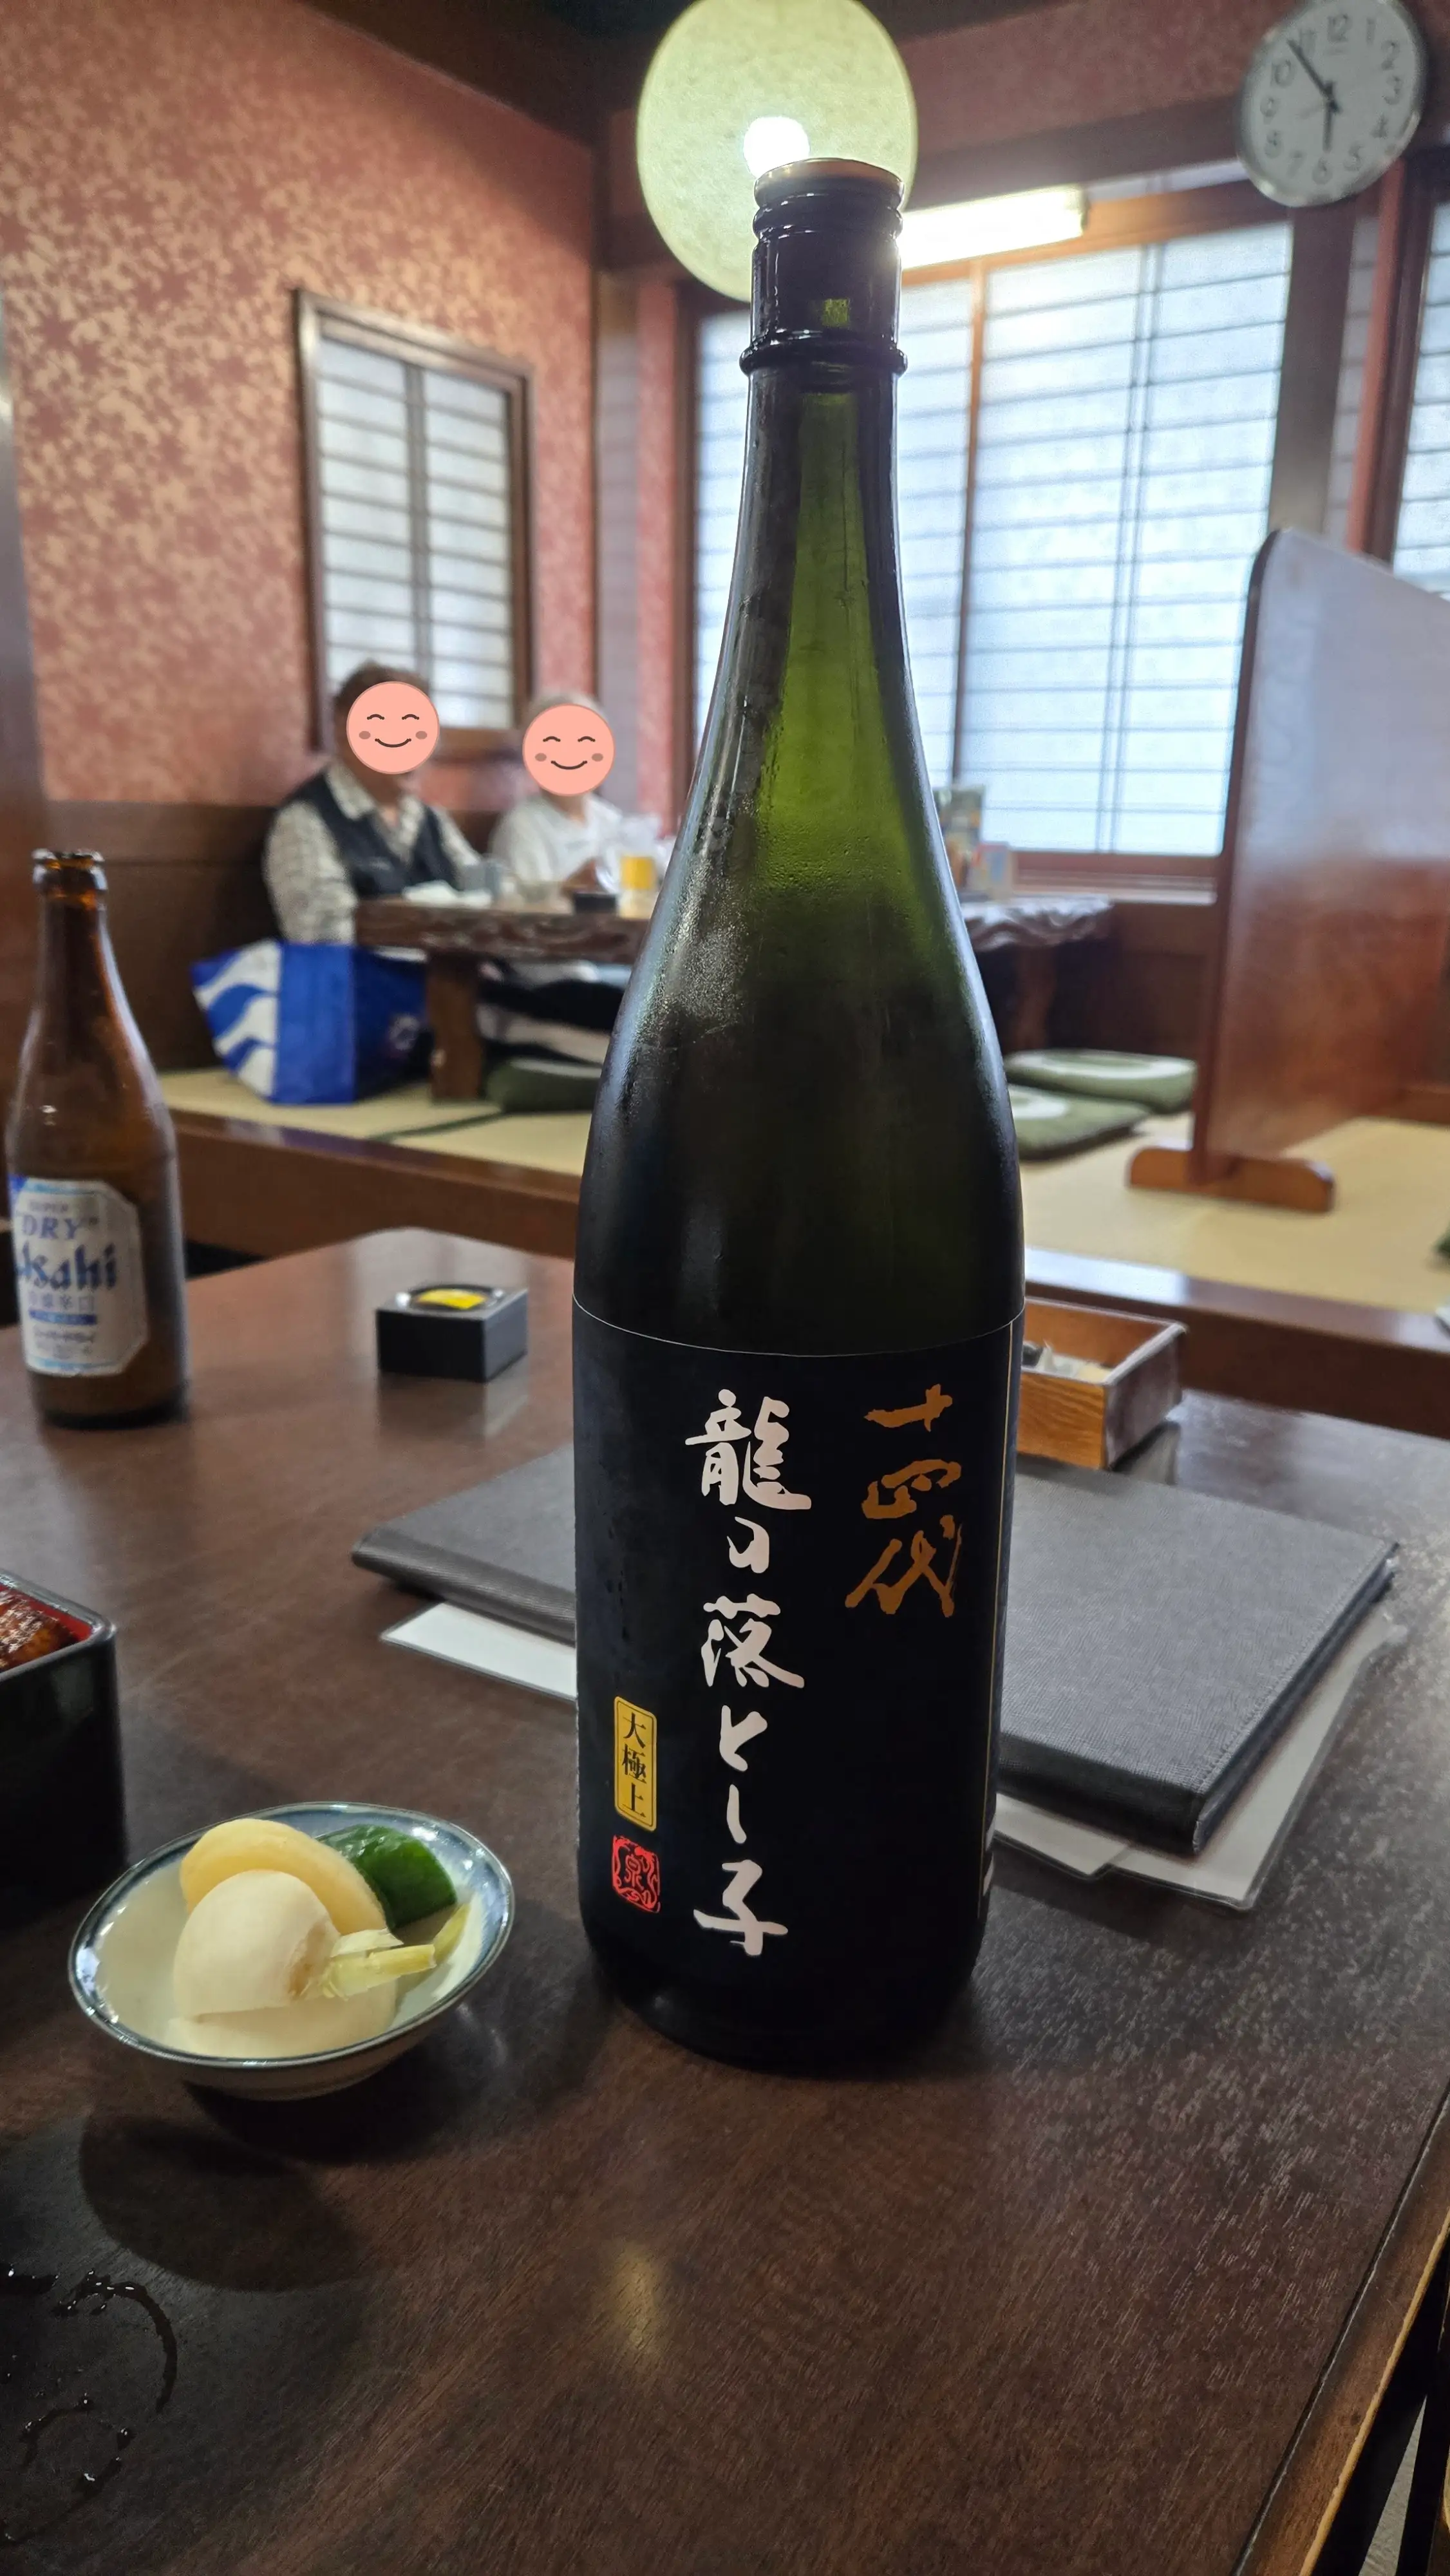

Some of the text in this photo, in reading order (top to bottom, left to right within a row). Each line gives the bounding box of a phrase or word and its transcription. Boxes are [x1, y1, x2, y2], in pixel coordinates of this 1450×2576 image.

[1327, 13, 1353, 43] 12
[1366, 16, 1377, 46] 1
[1381, 39, 1401, 70] 2
[1382, 75, 1404, 105] 3
[1260, 96, 1281, 124] 9
[1370, 113, 1388, 139] 4
[1264, 129, 1283, 158] 8
[1344, 141, 1364, 171] 5
[1312, 158, 1333, 185] 6
[22, 1215, 84, 1240] DRY
[845, 1384, 962, 1617] 十四代
[685, 1388, 812, 1956] 龍の落とし子
[622, 1712, 646, 1817] 大極上
